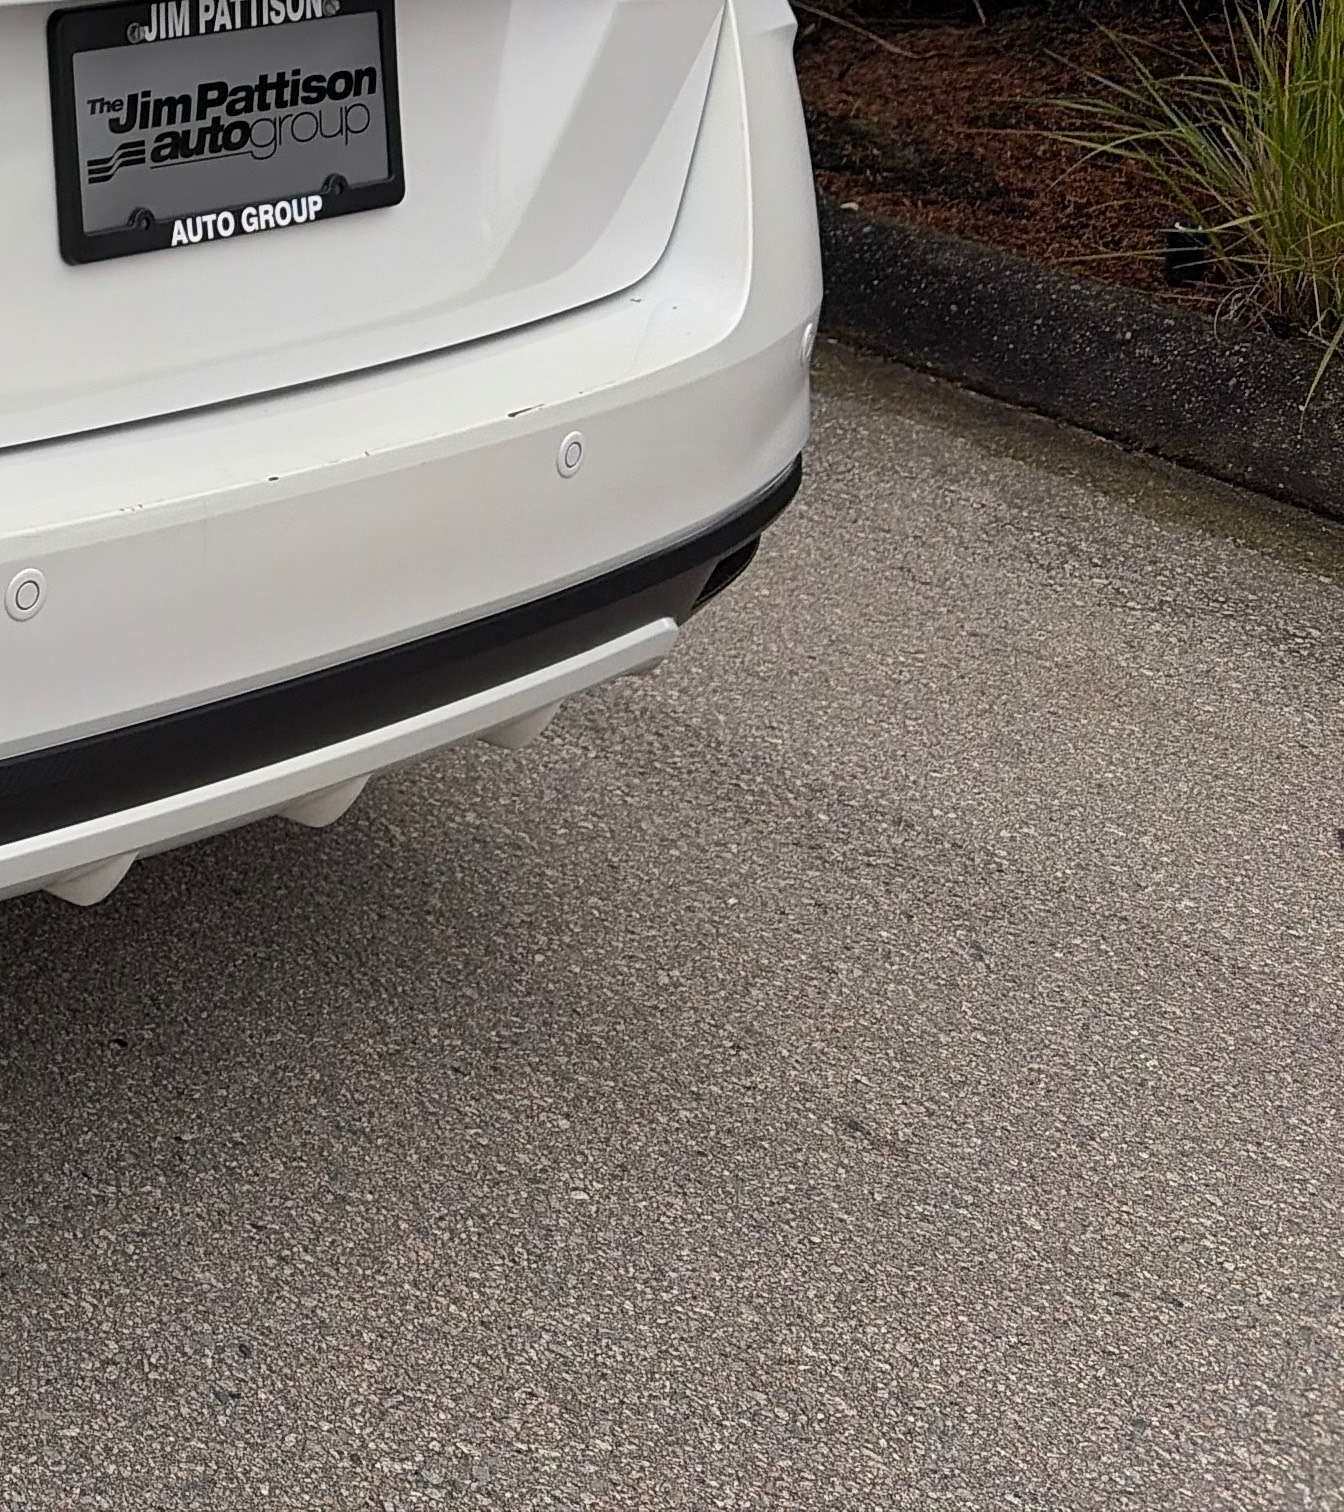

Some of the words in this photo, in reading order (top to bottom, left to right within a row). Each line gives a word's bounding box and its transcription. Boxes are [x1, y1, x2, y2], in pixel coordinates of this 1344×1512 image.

[142, 0, 190, 43] JIM
[87, 96, 124, 116] The
[171, 212, 235, 248] AUTO
[241, 194, 323, 234] GROUP
